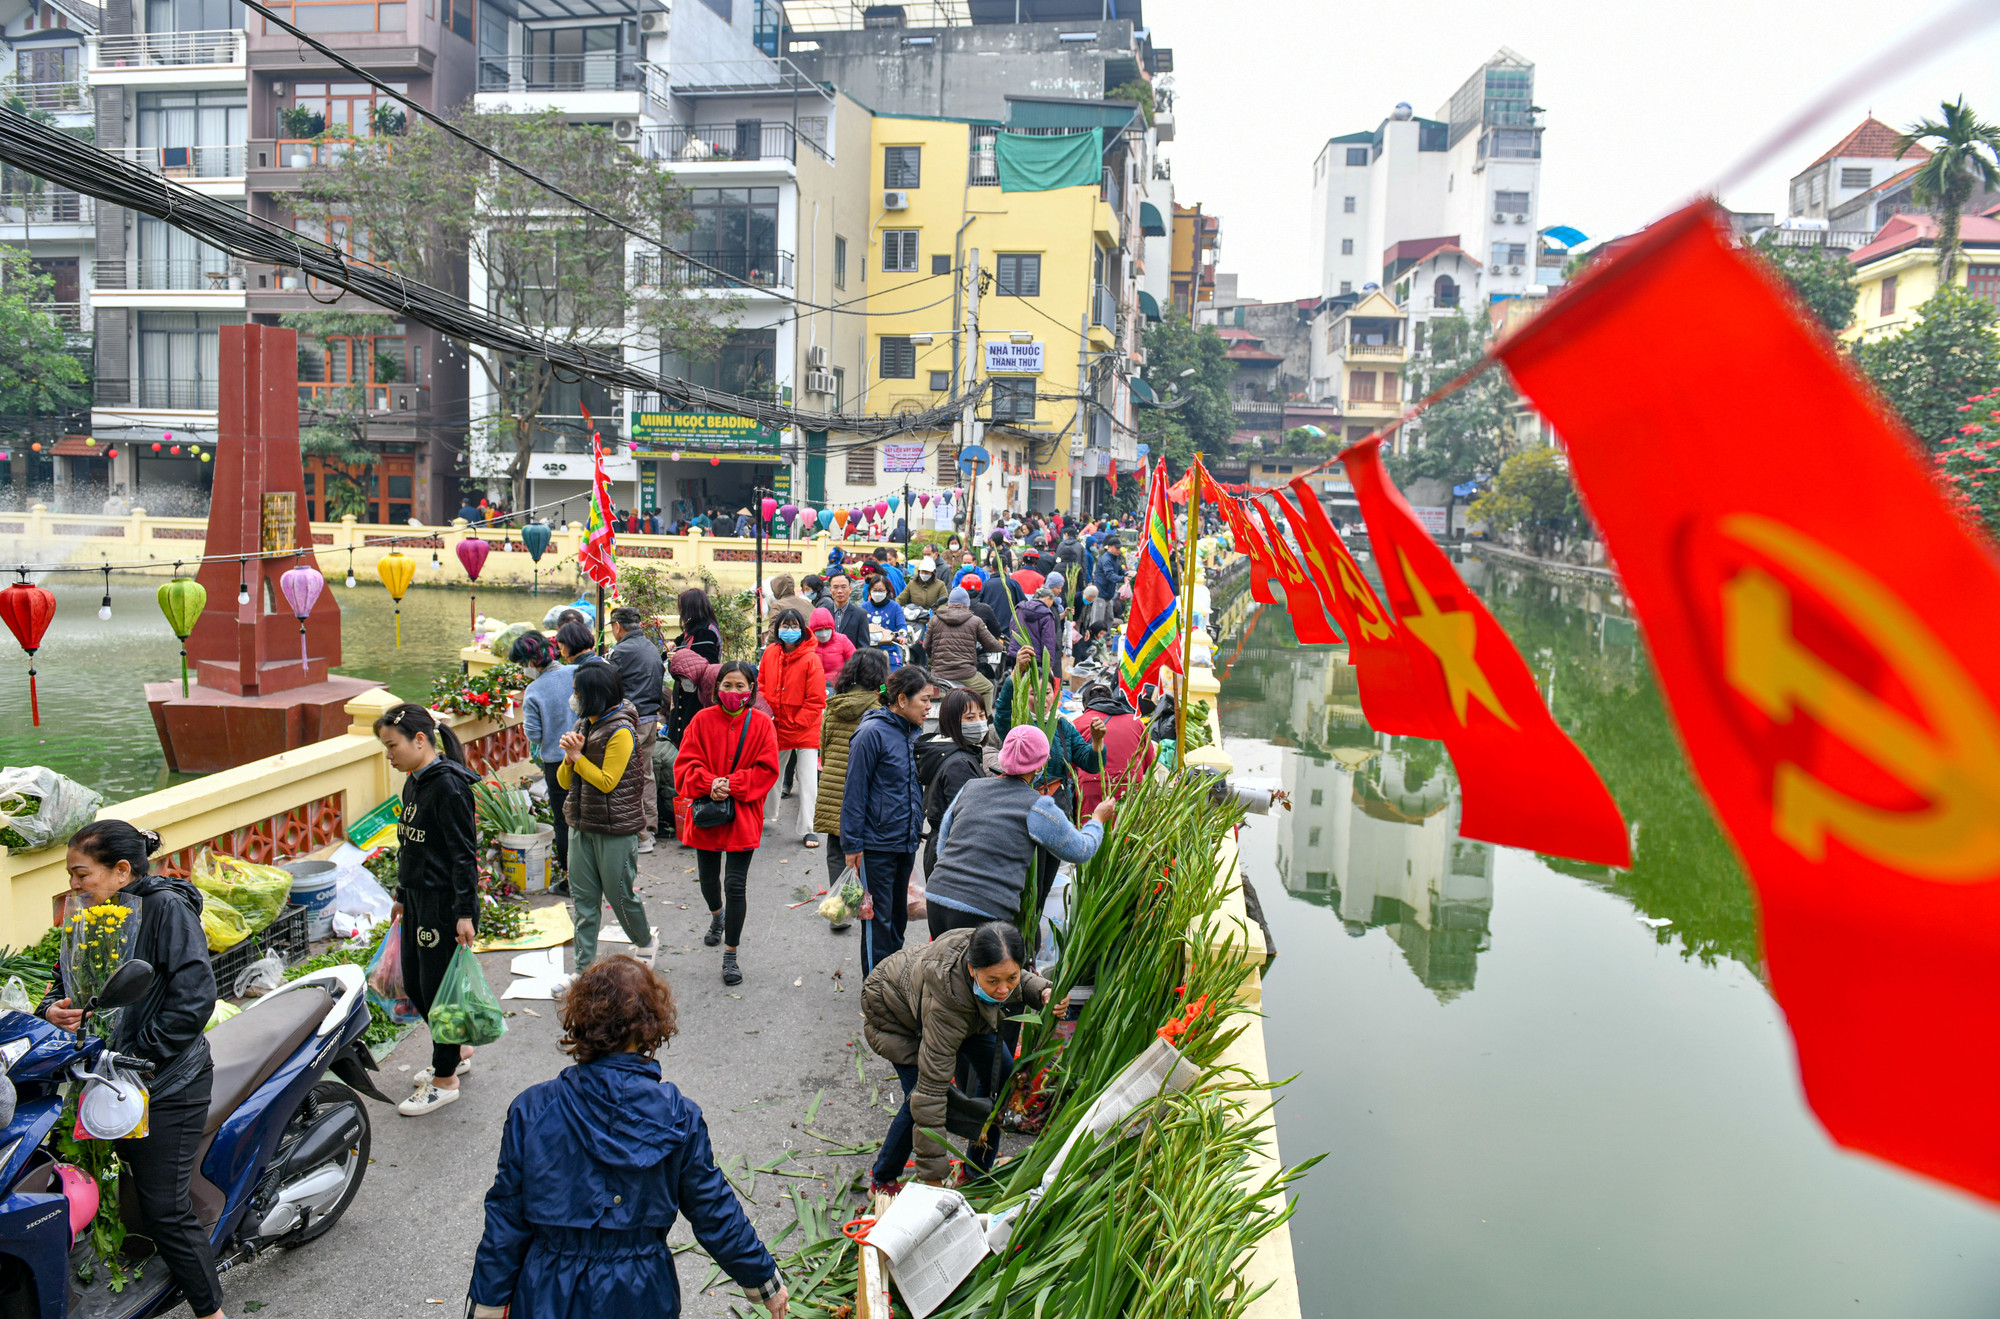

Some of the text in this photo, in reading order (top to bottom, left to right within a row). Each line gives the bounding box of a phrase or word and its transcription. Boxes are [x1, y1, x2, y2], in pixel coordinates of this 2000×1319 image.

[989, 344, 1040, 356] NHÀ THUỐC
[992, 358, 1017, 366] THANH
[641, 414, 757, 430] MINH NGỌC BEADING
[26, 1209, 62, 1230] HONDA
